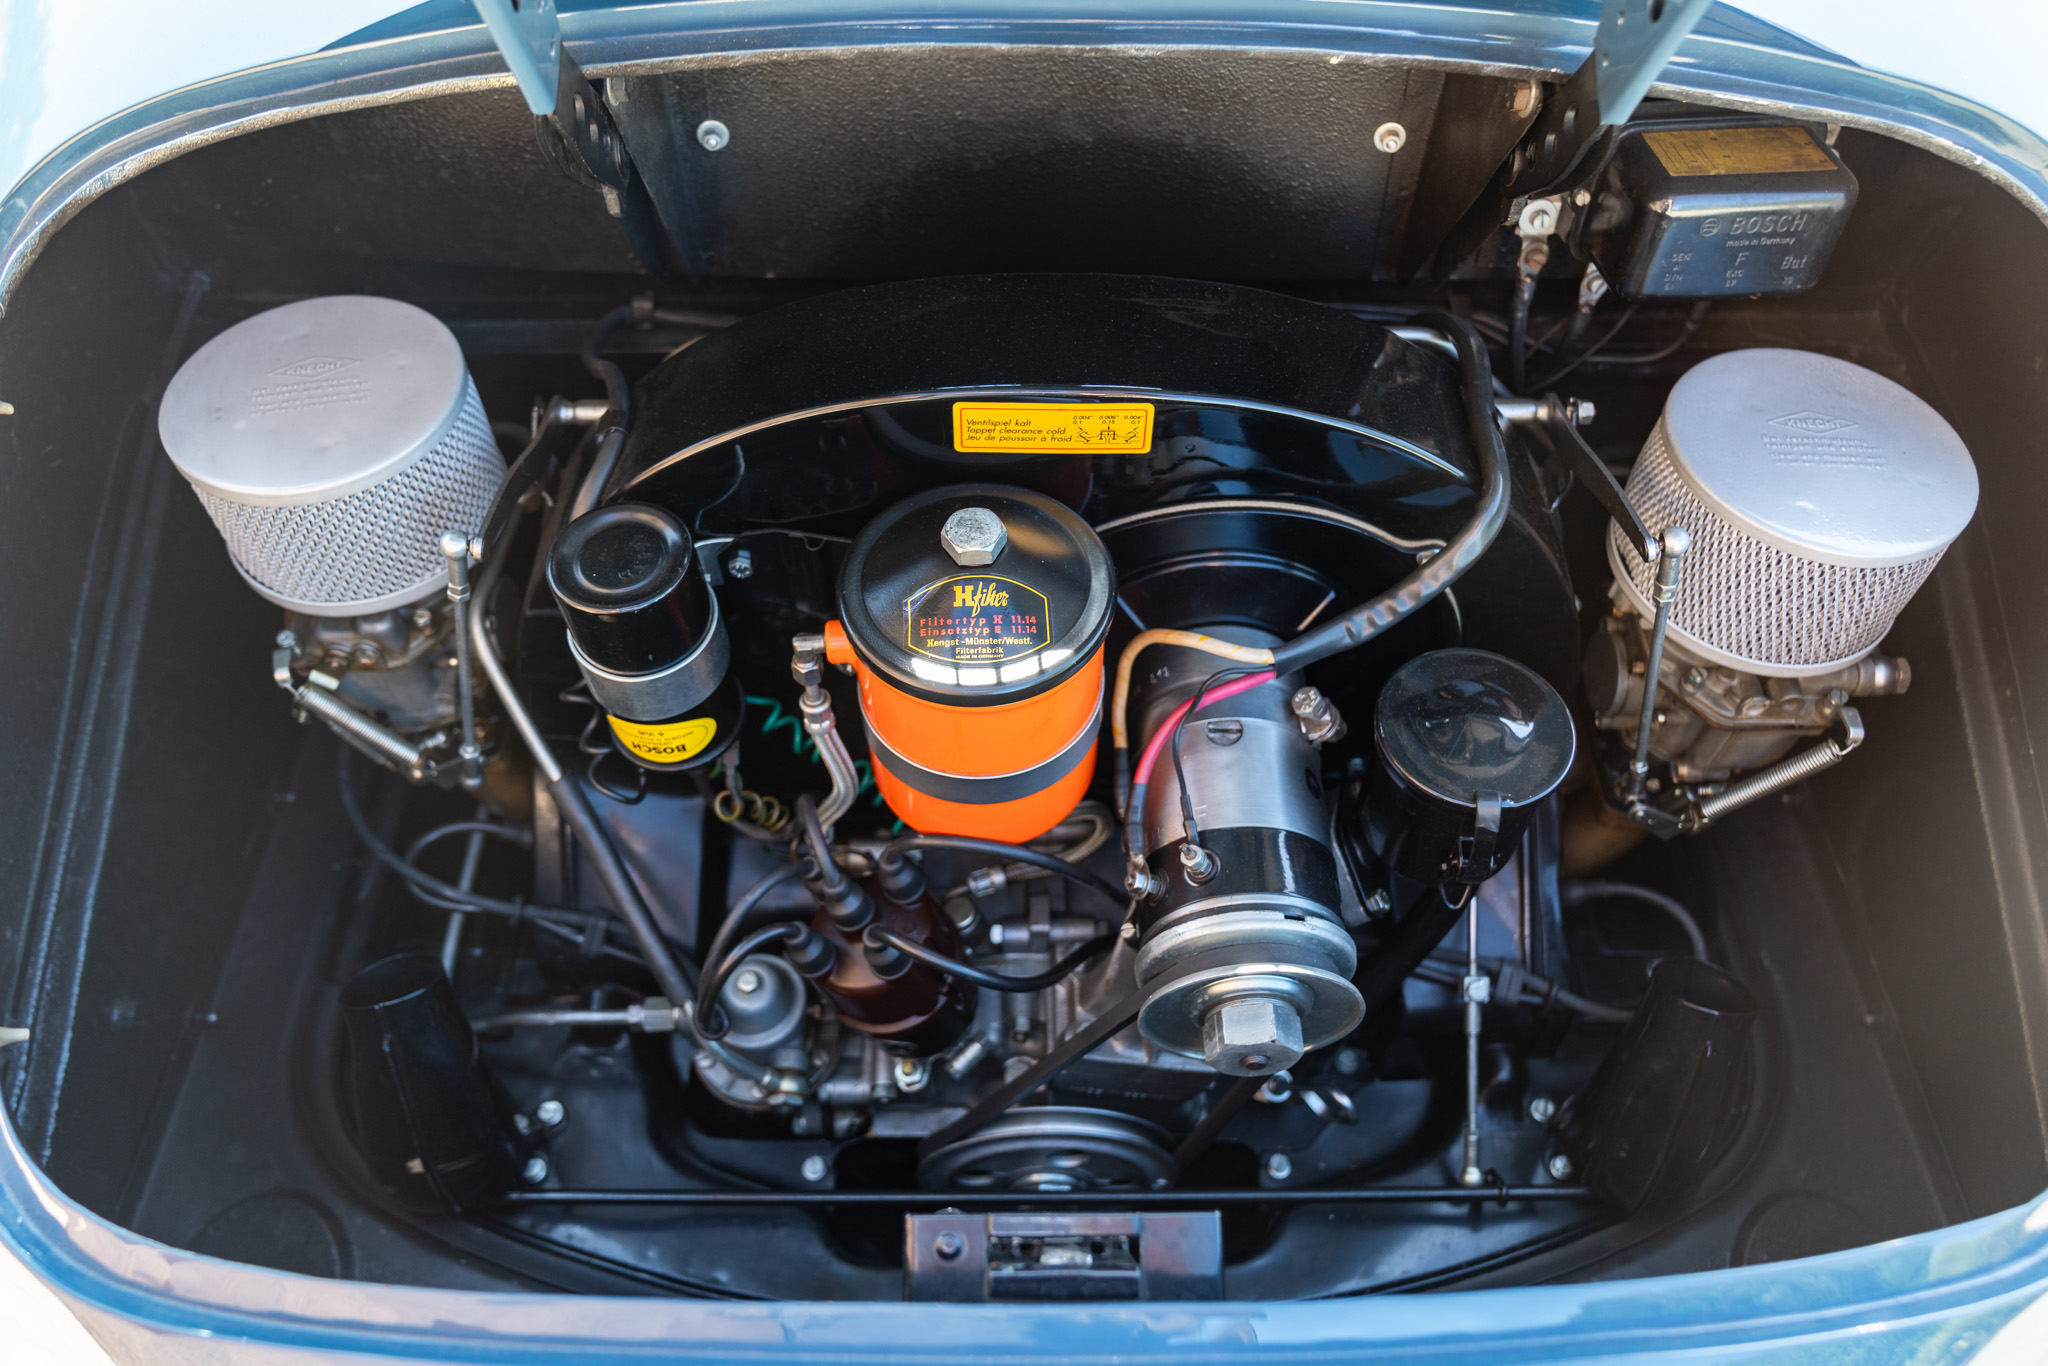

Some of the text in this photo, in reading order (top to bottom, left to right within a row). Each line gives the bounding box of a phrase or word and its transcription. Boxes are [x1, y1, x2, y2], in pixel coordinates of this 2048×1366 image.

[1730, 213, 1808, 235] BOSCH
[1726, 237, 1797, 247] made in Germany
[1734, 252, 1749, 266] F
[285, 361, 341, 376] KNECHT
[966, 419, 1032, 428] Ventilspiel kalt
[1784, 418, 1841, 429] KNECHT
[966, 426, 1067, 435] Tappet clearance cold
[999, 435, 1037, 443] poussoir
[1050, 435, 1073, 443] froid
[920, 615, 1037, 627] Filtertyp H 11.14
[920, 625, 1038, 637] Einsatztyp E 11.14
[927, 638, 960, 648] Hengst
[955, 646, 1005, 655] Filterfabrik
[631, 740, 688, 754] BOSCH
